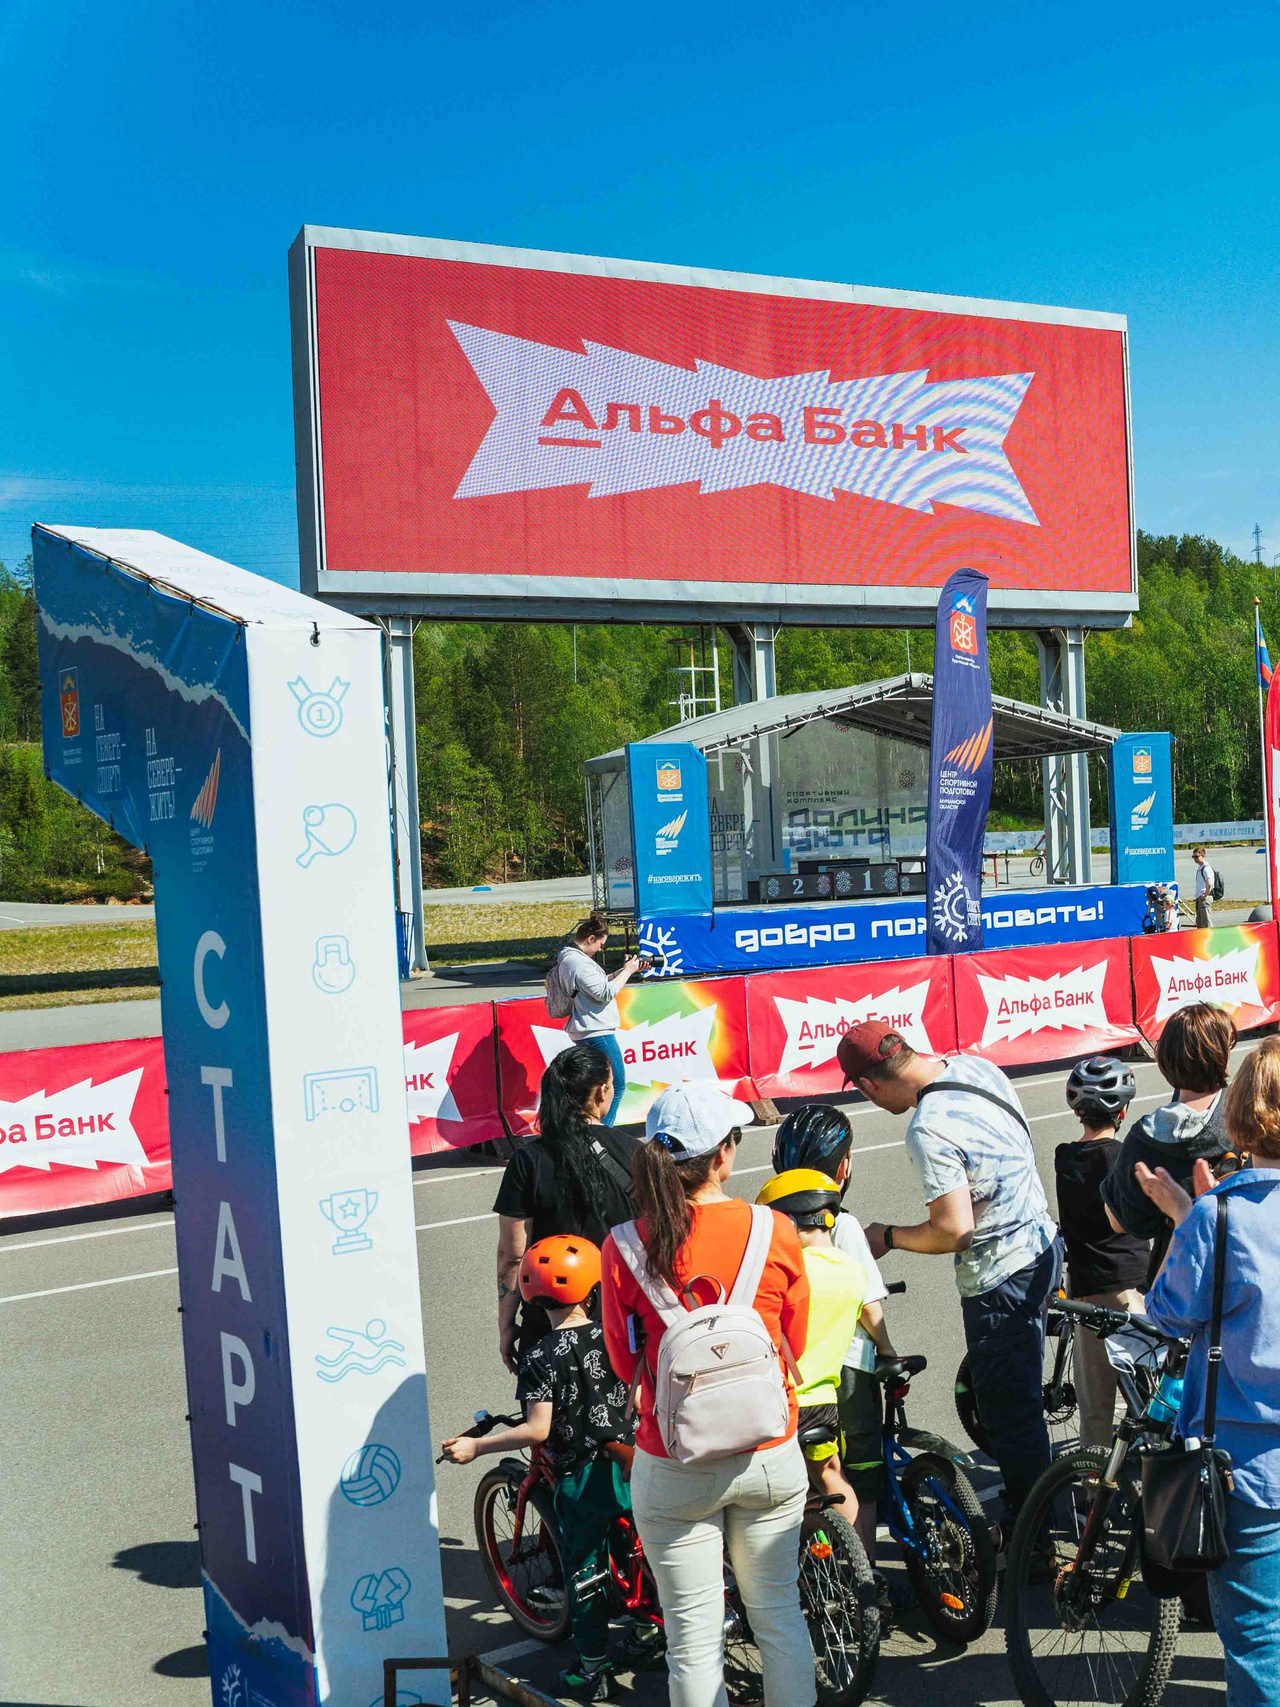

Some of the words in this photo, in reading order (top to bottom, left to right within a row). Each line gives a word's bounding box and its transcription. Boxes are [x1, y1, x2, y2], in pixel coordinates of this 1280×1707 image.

[539, 387, 785, 448] Альфа
[803, 405, 969, 454] Банк
[145, 727, 157, 756] НА
[939, 778, 978, 788] СПОРТИВНОЙ
[940, 770, 958, 778] ЦЕНТР
[939, 787, 976, 796] ПОДГОТОВКИ
[648, 873, 702, 884] #насевережить
[793, 878, 804, 895] 2
[863, 870, 873, 891] 1
[1168, 973, 1212, 994] Альфа
[1215, 970, 1248, 987] Банк
[998, 993, 1051, 1017] Альфа
[1054, 990, 1094, 1008] Банк
[642, 1040, 697, 1062] Банк
[405, 1072, 435, 1092] нк
[34, 1112, 116, 1140] Банк
[193, 929, 262, 1564] СТАРТ
